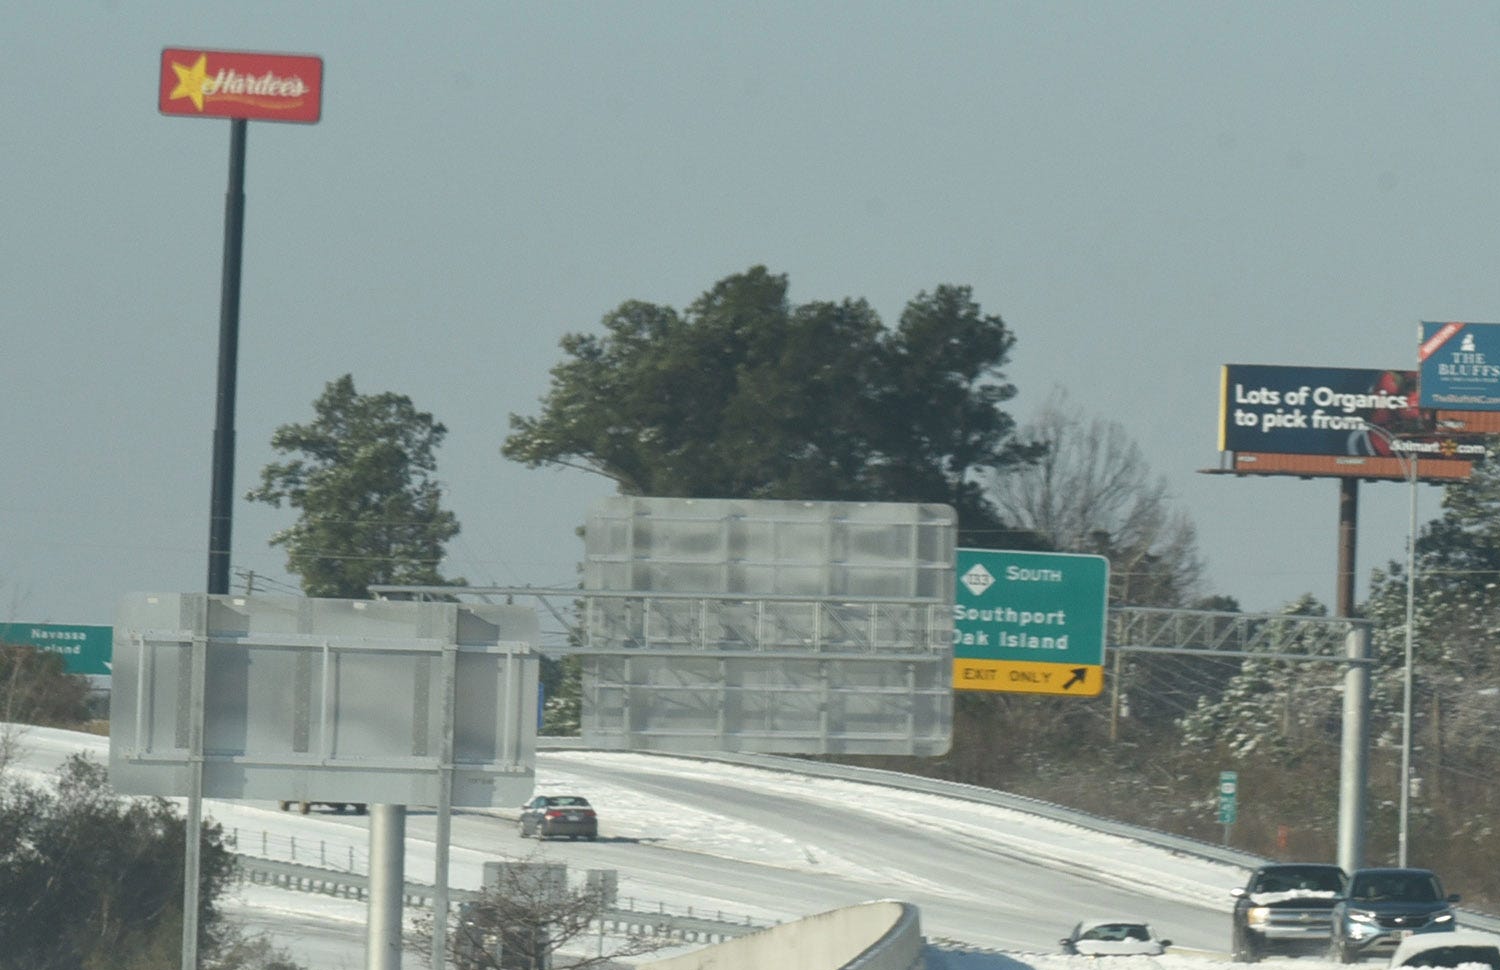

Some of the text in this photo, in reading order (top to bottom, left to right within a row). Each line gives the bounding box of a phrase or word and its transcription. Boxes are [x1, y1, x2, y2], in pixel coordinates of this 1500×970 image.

[1451, 352, 1487, 365] THE
[1235, 384, 1409, 413] Lots of Organics
[1234, 408, 1258, 427] to
[1262, 409, 1308, 433] pick
[1006, 565, 1062, 582] SOUTH
[953, 604, 1066, 626] Southport
[999, 630, 1069, 650] Island
[964, 668, 1052, 684] EXIT ONLY
